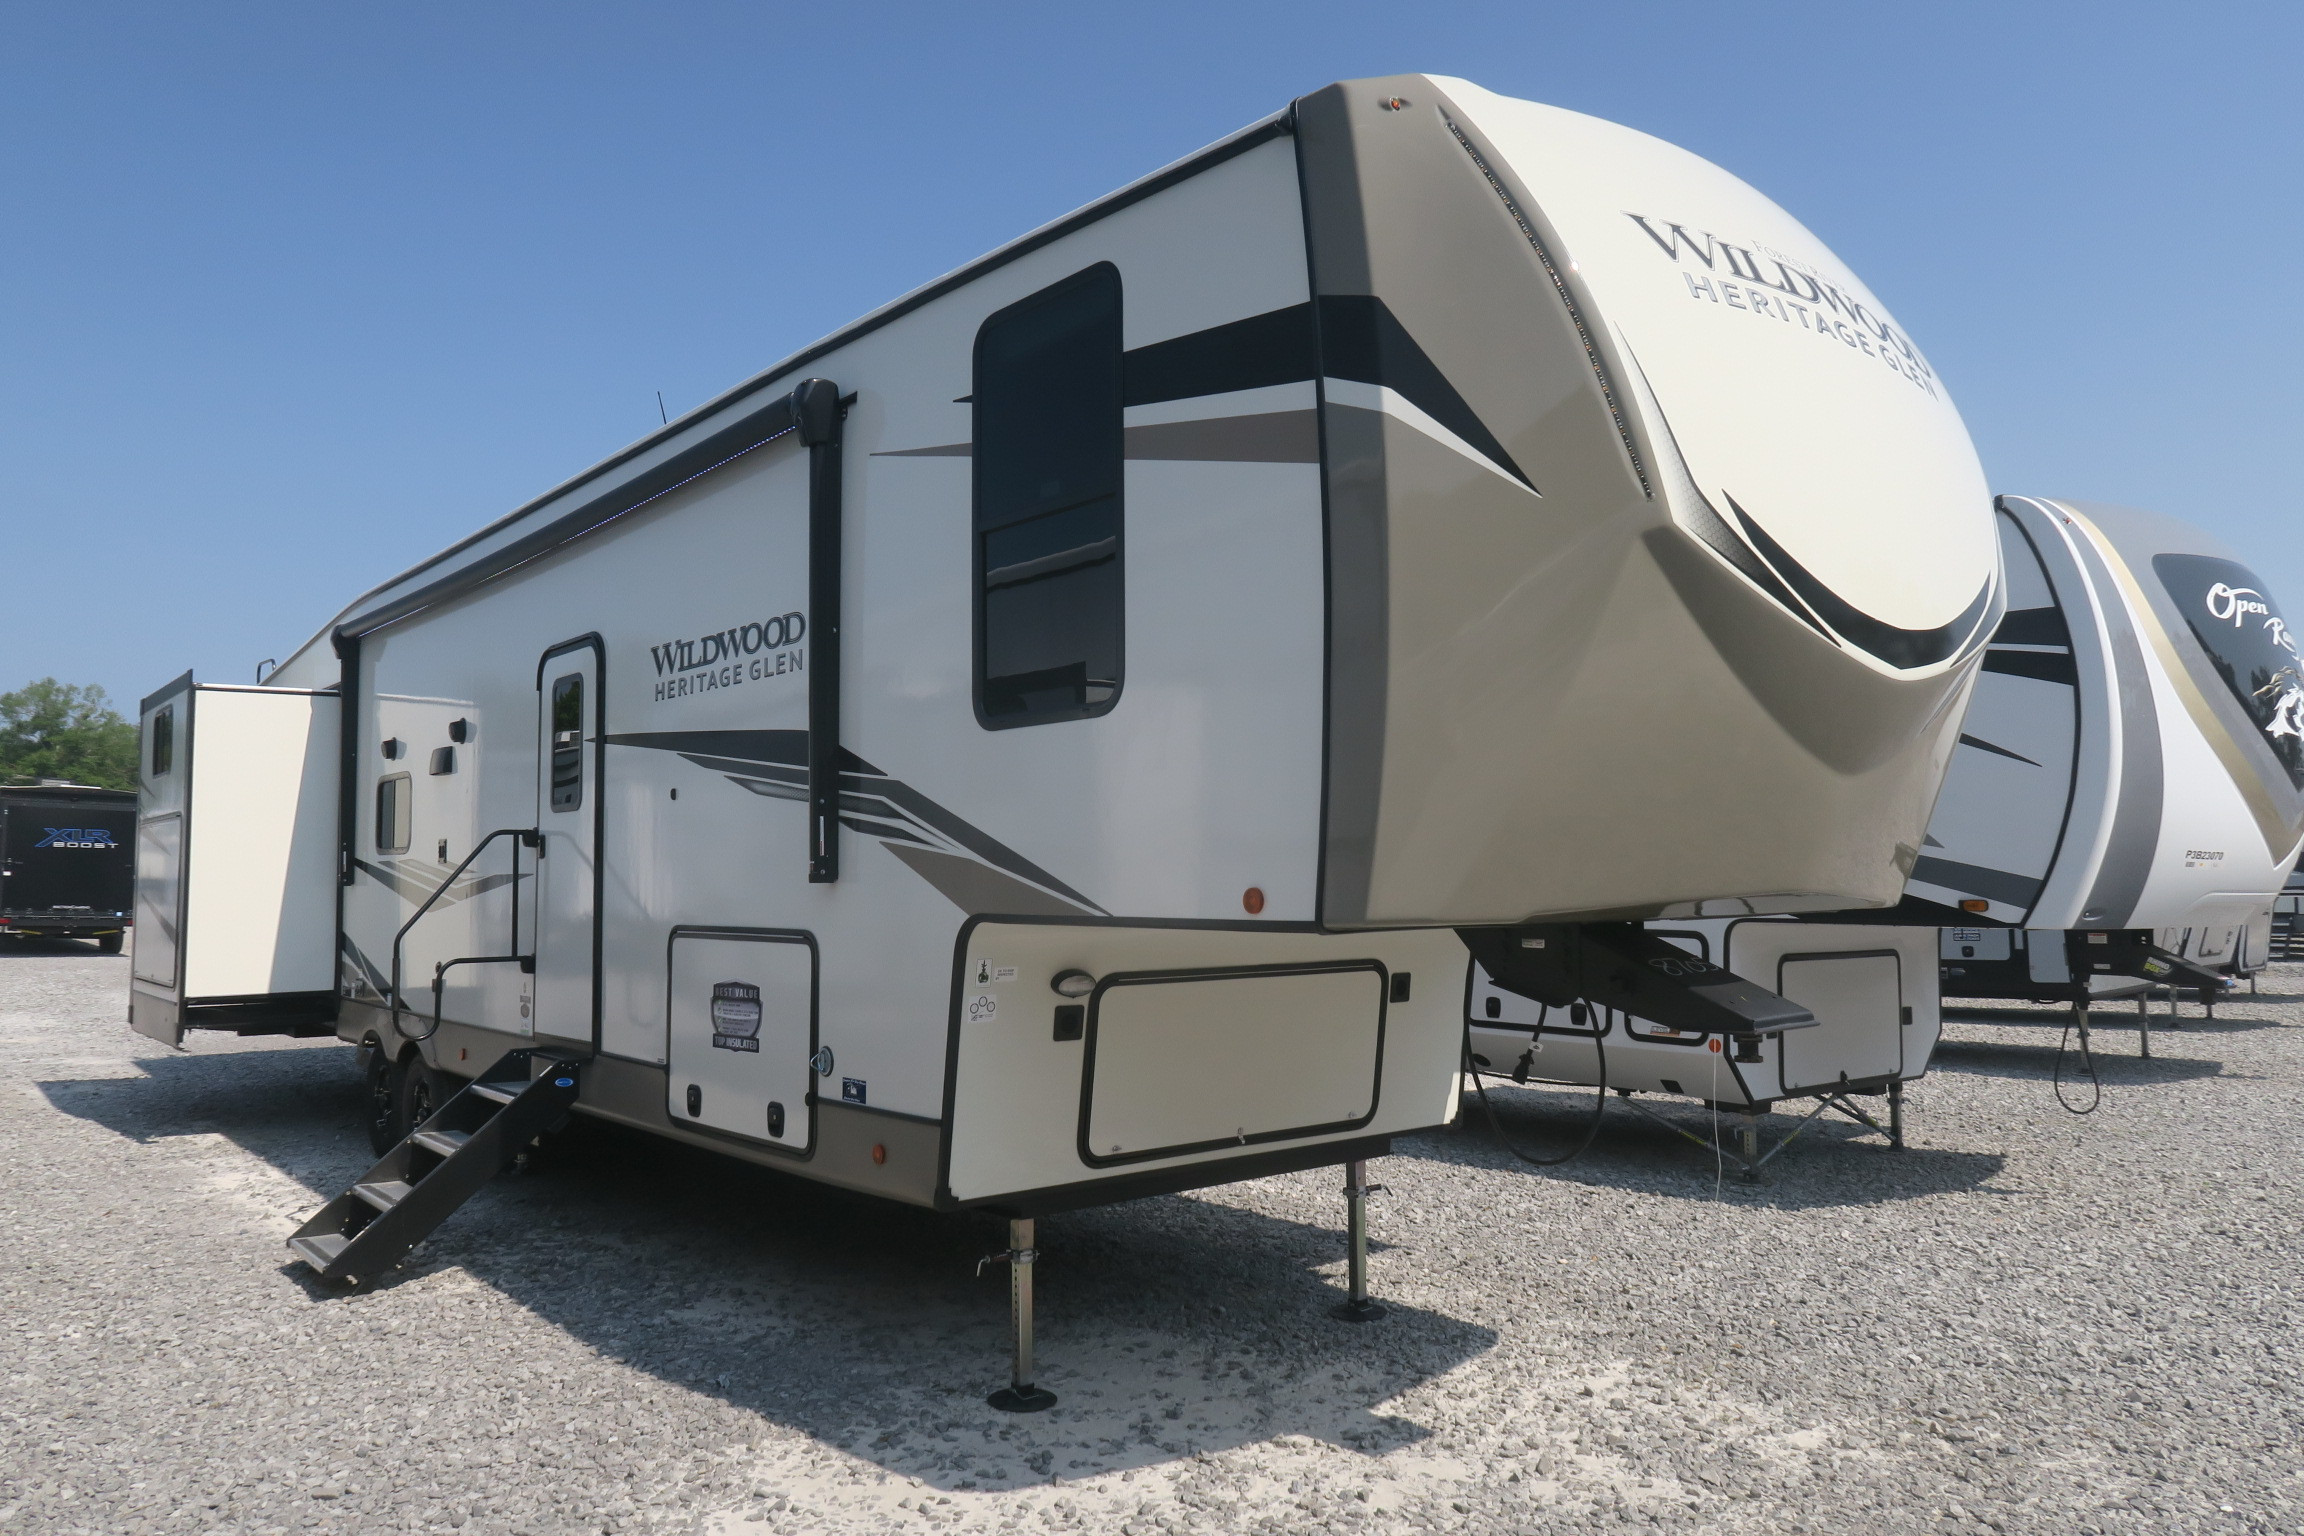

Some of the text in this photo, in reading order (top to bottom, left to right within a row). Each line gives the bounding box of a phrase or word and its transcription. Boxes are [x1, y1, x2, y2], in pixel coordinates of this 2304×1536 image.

[1619, 209, 1932, 379] WILDWOOD
[1682, 271, 1939, 402] HERITAGE GLEN
[2206, 582, 2269, 628] Open
[650, 611, 806, 677] WILDWOOD
[655, 648, 803, 702] HERITAGE GLEN
[34, 827, 114, 847] XLR
[2185, 849, 2224, 861] P3B23070
[715, 987, 759, 999] BEST VALUE
